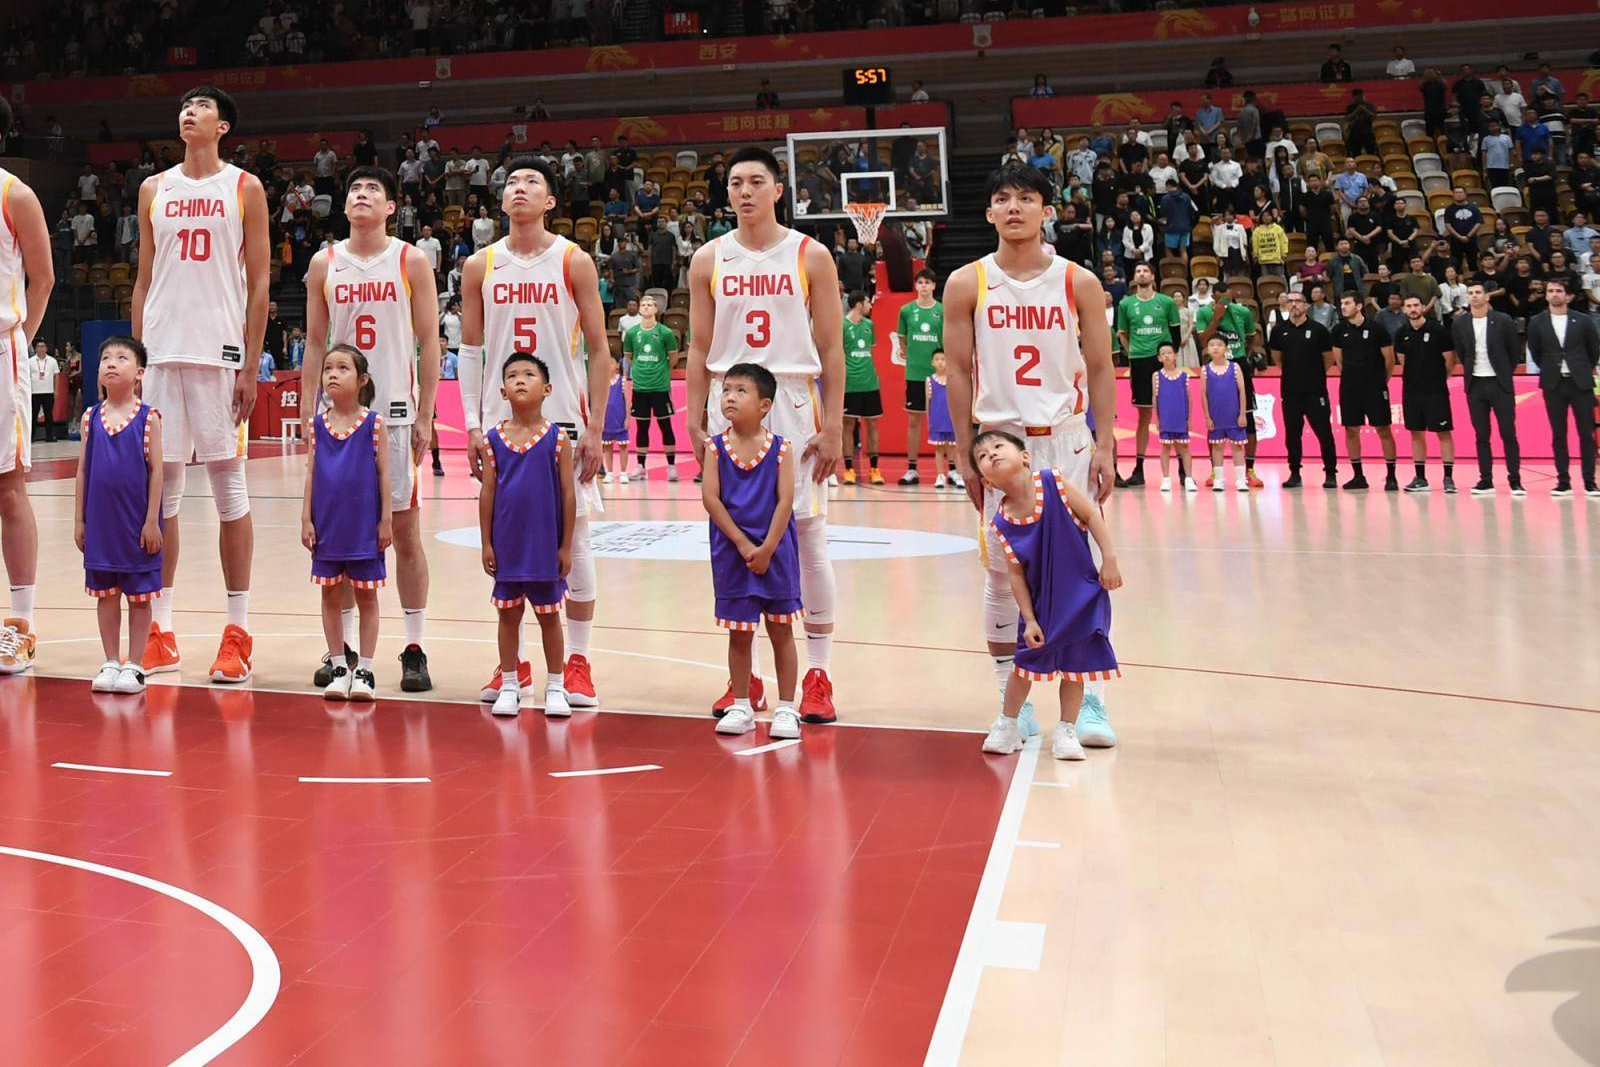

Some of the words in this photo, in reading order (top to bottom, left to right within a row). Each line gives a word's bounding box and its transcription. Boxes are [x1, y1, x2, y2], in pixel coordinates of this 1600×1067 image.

[1263, 3, 1355, 23] 一路向征程
[699, 43, 737, 60] 西安
[855, 68, 887, 85] 5:57
[706, 113, 791, 131] 一路向征程
[165, 197, 226, 219] CHINA
[176, 228, 211, 262] 10
[335, 281, 398, 304] CHINA
[493, 282, 559, 305] CHINA
[722, 274, 794, 297] CHINA
[987, 304, 1066, 331] CHINA
[354, 314, 376, 351] 6
[513, 316, 538, 354] 5
[745, 310, 771, 349] 3
[1014, 345, 1042, 387] 2
